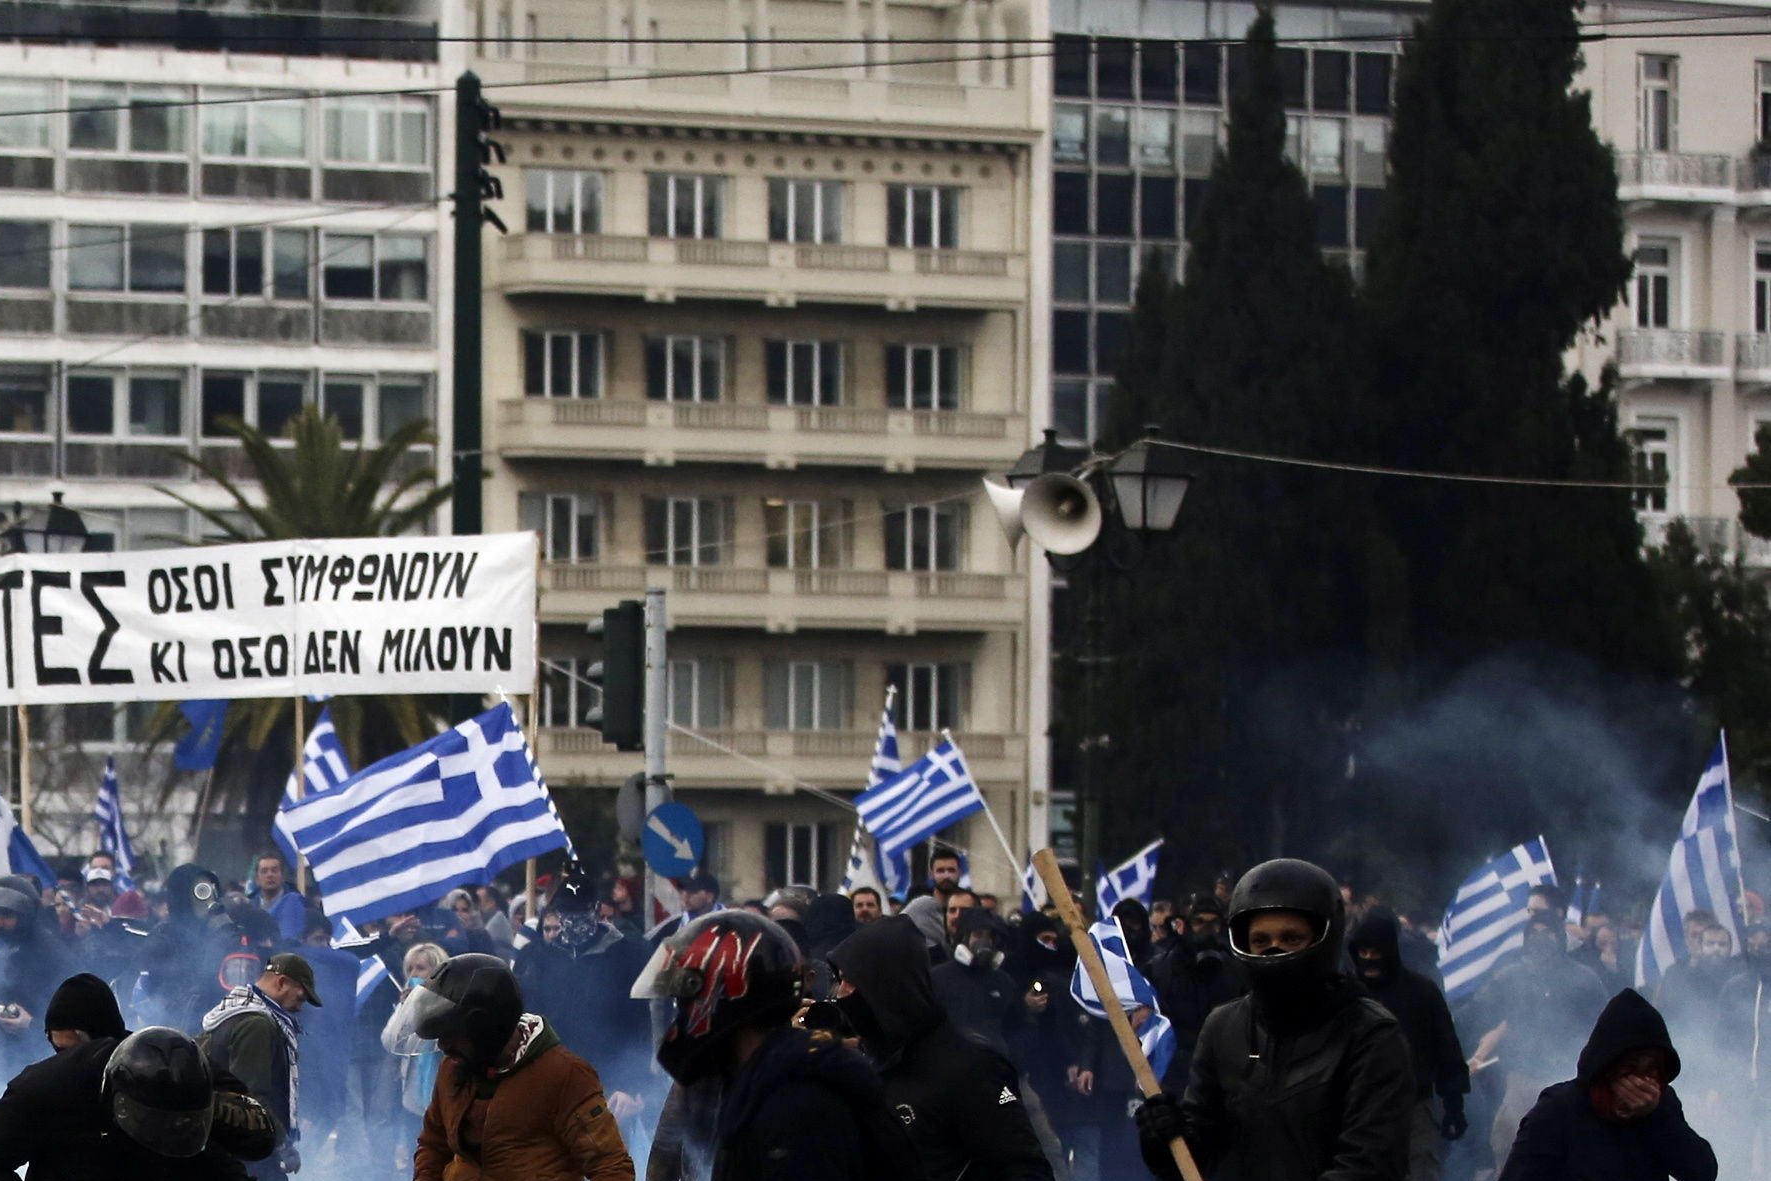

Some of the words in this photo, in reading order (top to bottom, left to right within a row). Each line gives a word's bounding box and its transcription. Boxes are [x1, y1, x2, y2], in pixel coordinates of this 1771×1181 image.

[147, 563, 234, 614] ΟΣΟΙ
[261, 552, 479, 607] ΣΥΜΦΩΝΟΥΝ
[150, 641, 188, 683] ΚΙ
[212, 634, 296, 679] ΟΣΟ
[303, 630, 361, 675] ΔΕΝ
[378, 626, 512, 673] ΜΙΛΟΥΝ
